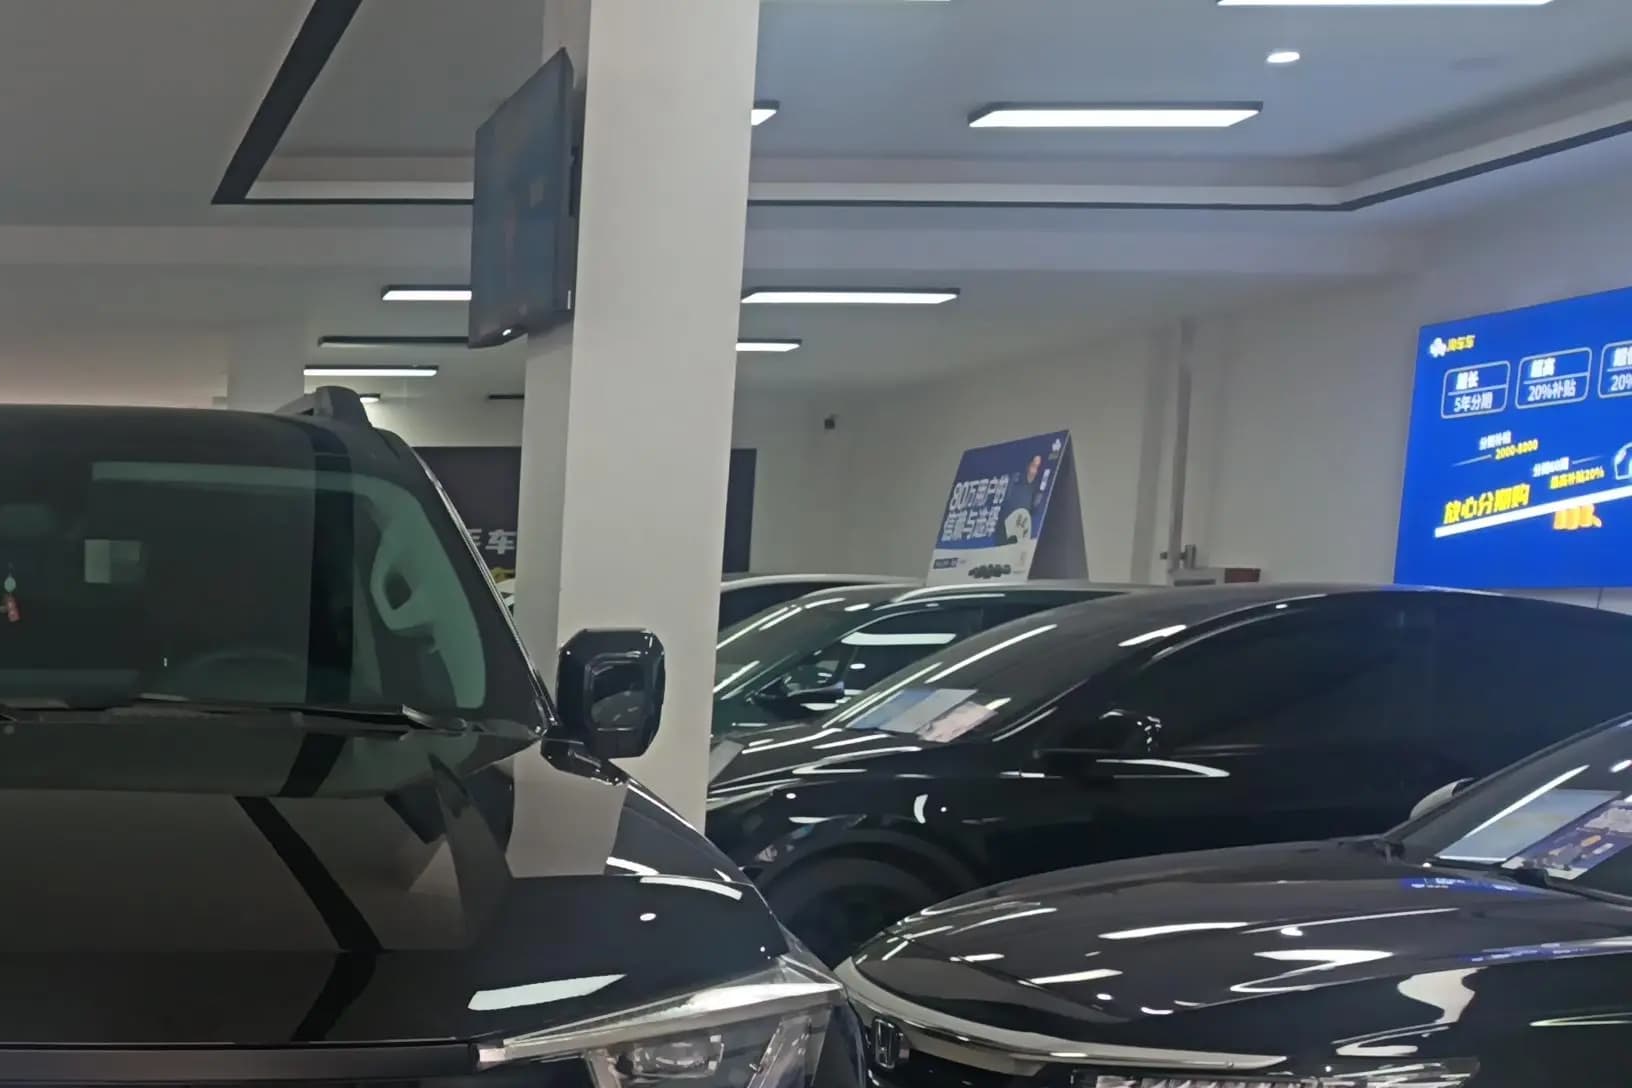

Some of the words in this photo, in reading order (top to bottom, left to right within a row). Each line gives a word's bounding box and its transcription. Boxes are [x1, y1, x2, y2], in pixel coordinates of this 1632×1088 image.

[1527, 379, 1577, 402] 20%补贴
[1454, 391, 1493, 413] 5年分期
